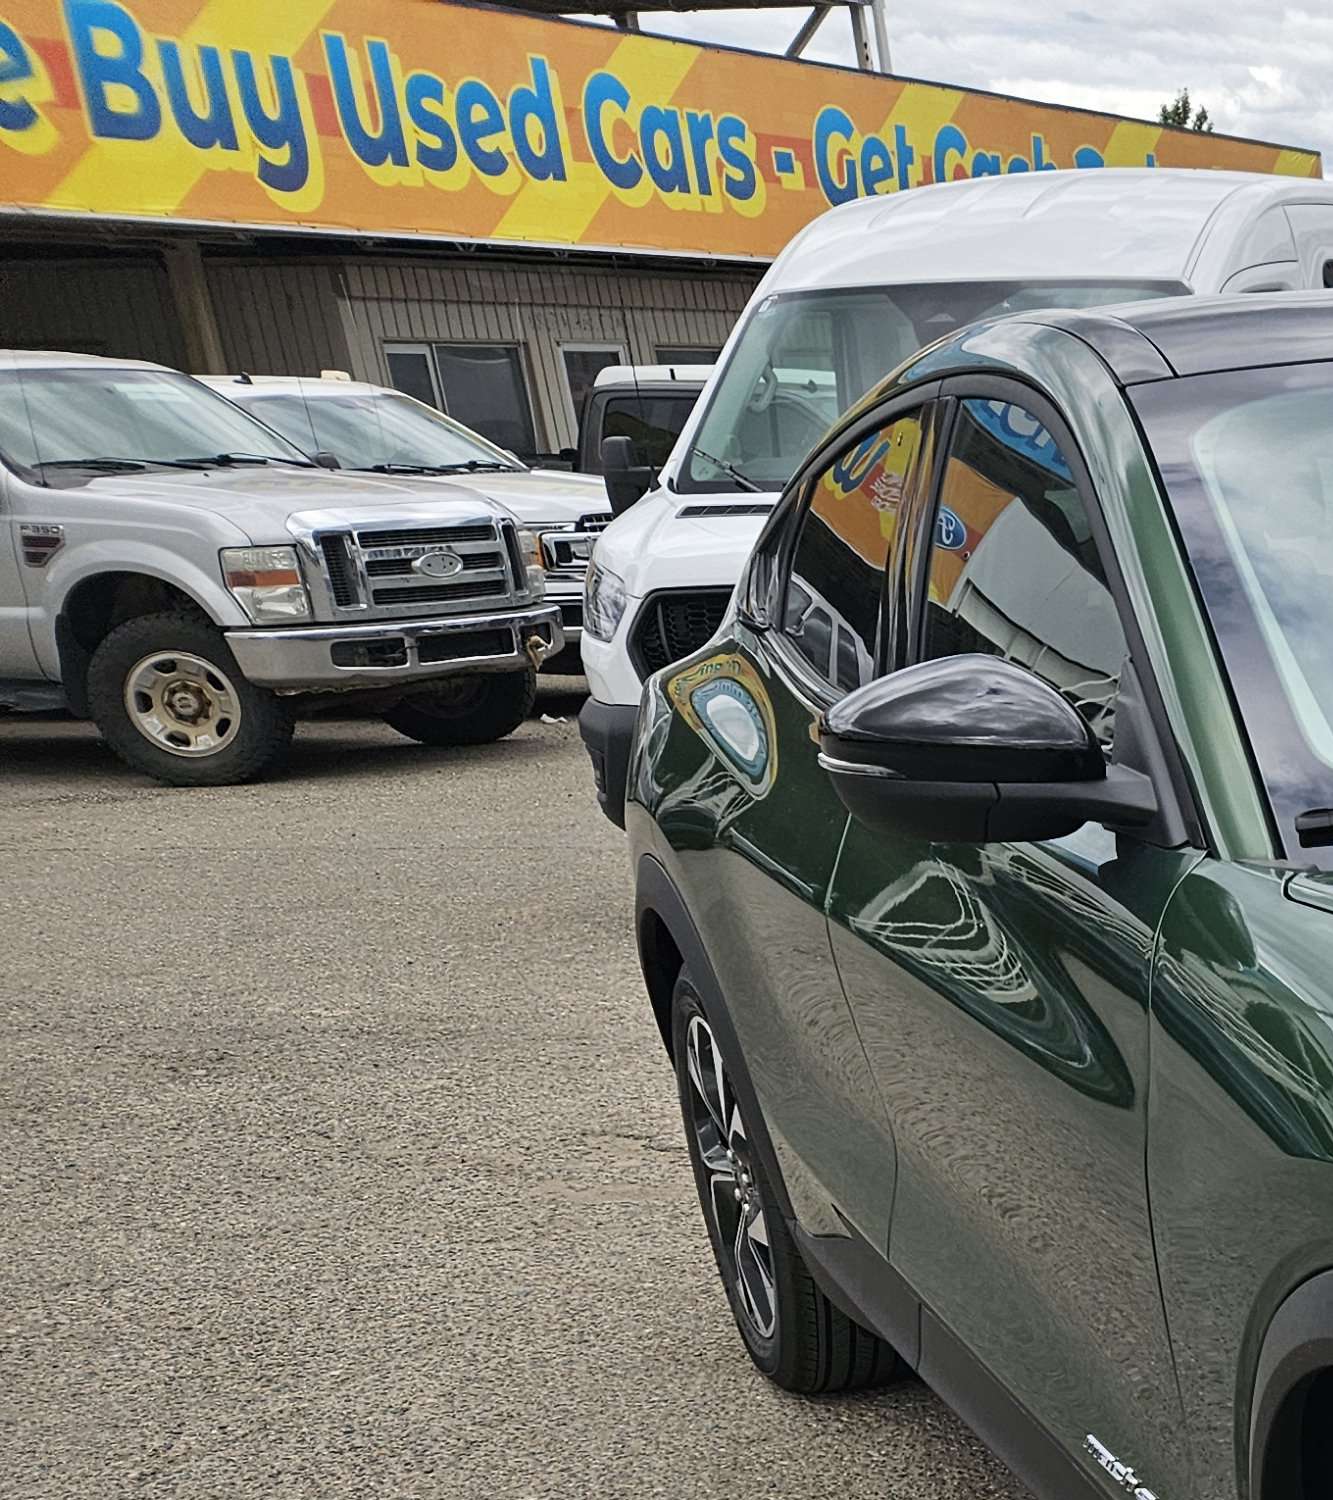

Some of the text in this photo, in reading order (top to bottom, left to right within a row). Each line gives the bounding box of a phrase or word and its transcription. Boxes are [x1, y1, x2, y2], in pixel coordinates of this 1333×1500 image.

[64, 0, 309, 192] Buy
[321, 34, 567, 182] Used
[584, 72, 756, 201] Cars
[814, 107, 914, 206] Get
